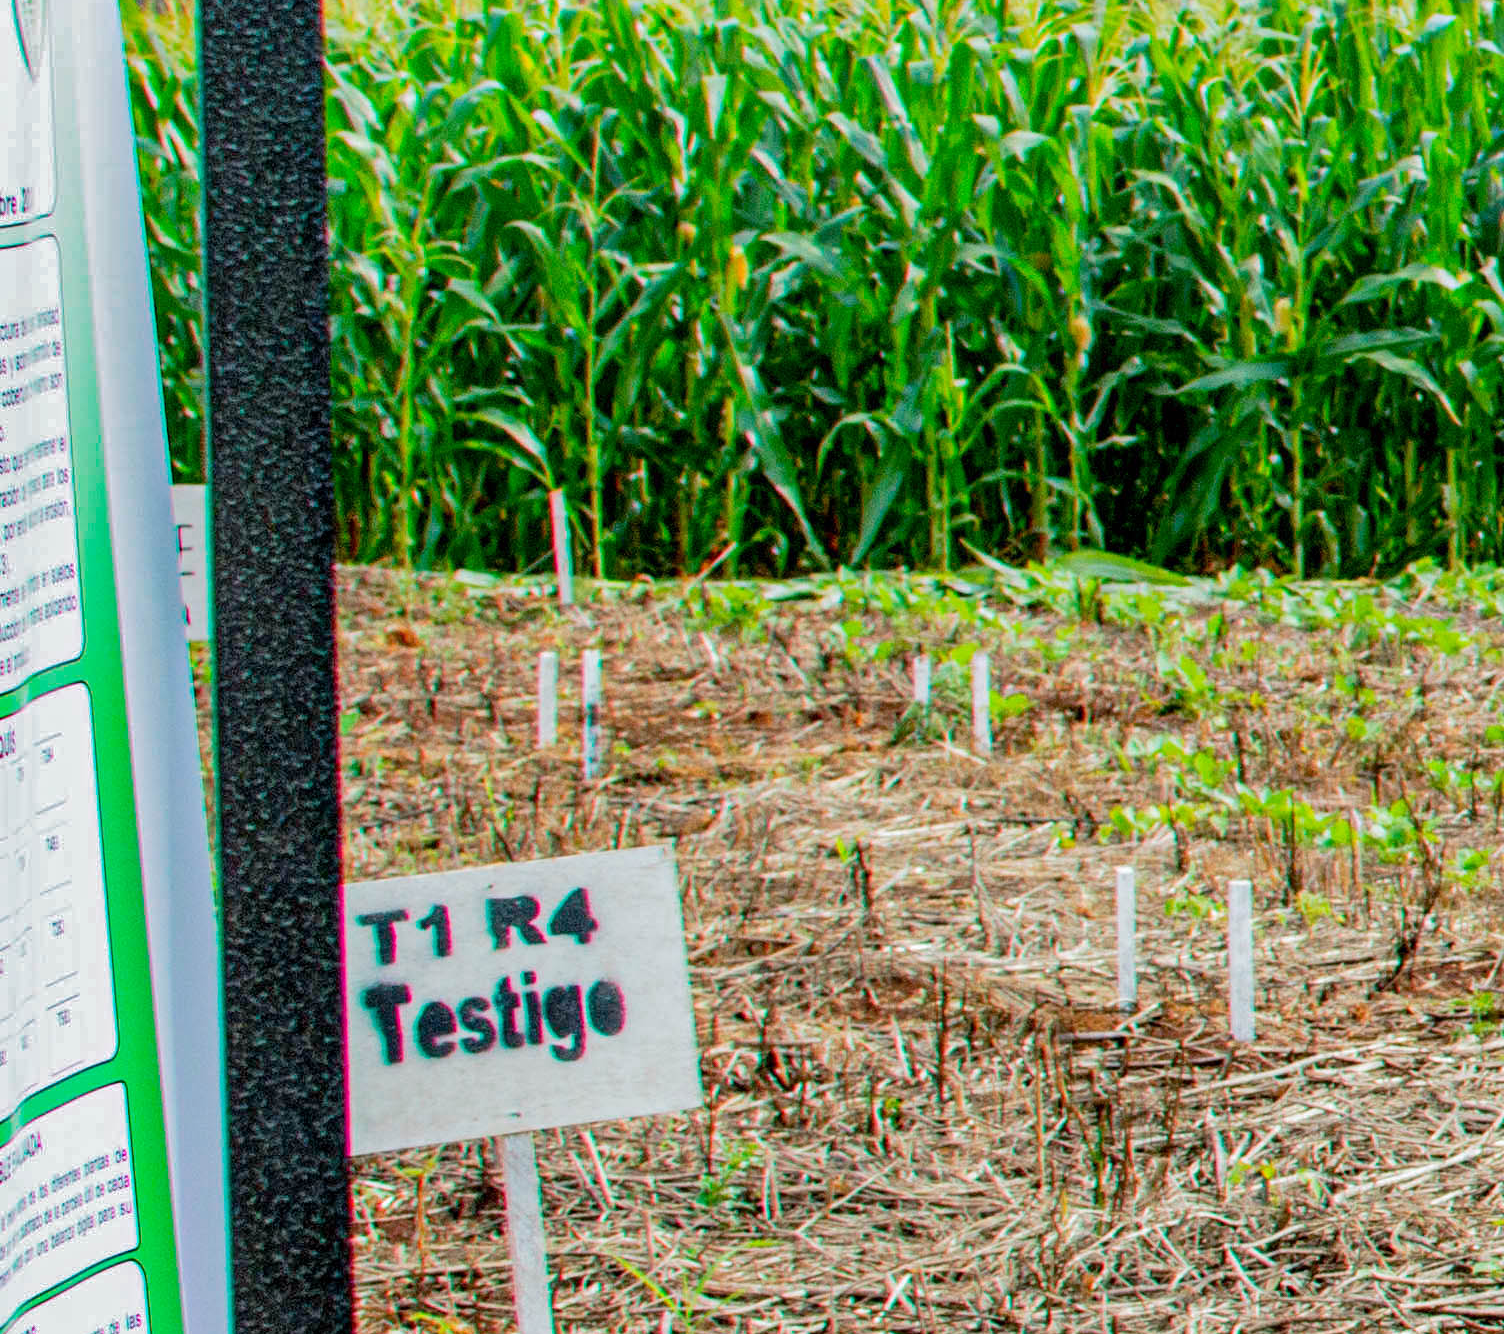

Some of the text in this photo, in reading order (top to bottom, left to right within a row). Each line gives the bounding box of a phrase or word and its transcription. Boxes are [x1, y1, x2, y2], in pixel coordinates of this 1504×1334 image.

[356, 886, 600, 966] T1 R4
[361, 969, 627, 1066] Testigo
